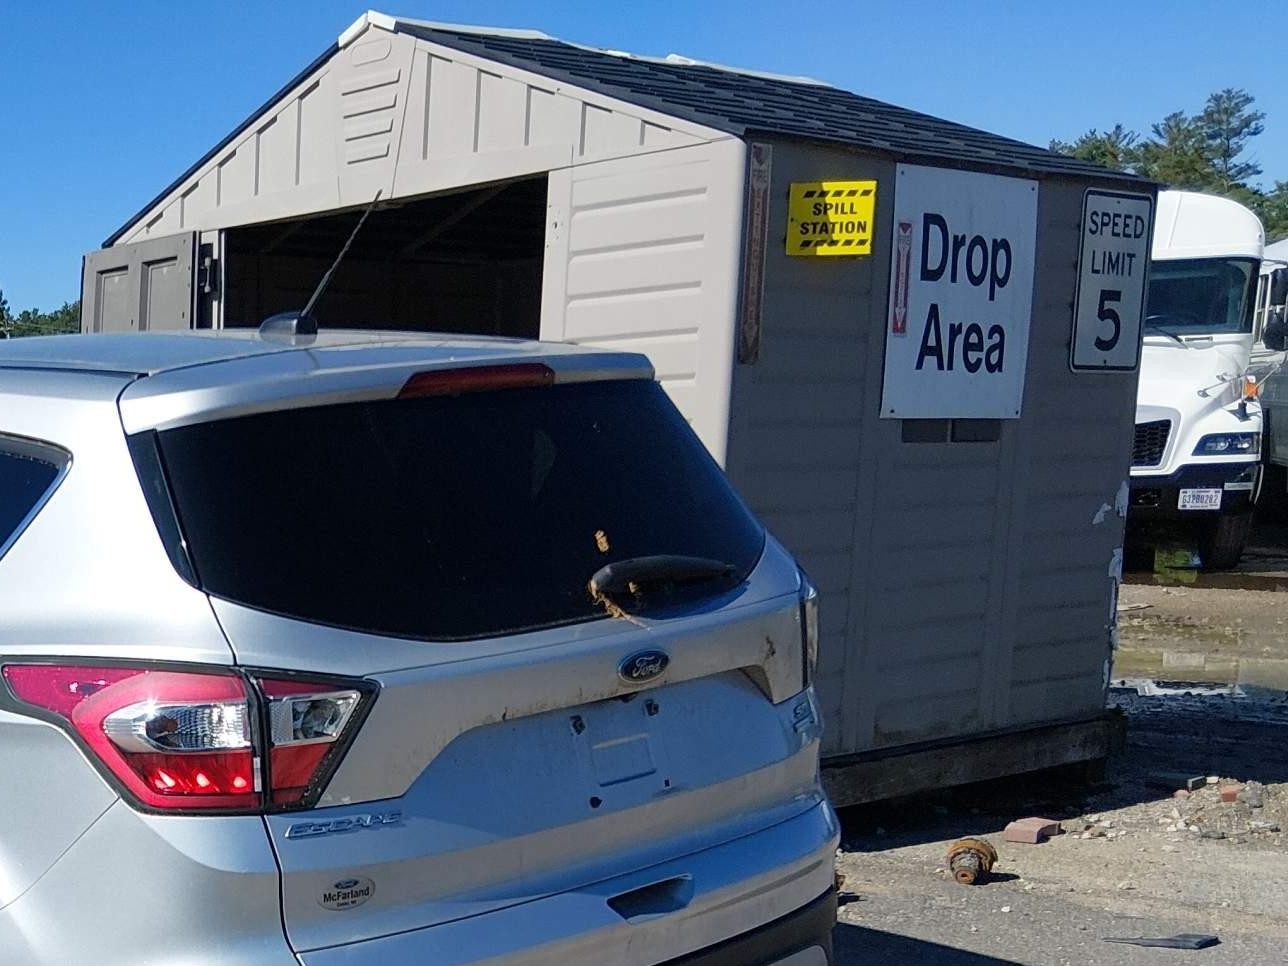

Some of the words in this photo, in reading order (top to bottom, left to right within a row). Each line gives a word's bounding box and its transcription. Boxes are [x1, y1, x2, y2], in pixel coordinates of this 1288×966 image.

[812, 202, 857, 216] SPILL
[799, 221, 867, 236] STATION
[1088, 210, 1145, 239] SPEED
[920, 212, 1012, 302] Drop
[1091, 250, 1136, 277] LIMIT
[1094, 289, 1122, 352] 5
[915, 303, 1005, 374] Area
[631, 655, 663, 678] Ford
[284, 810, 402, 839] ESCAPE
[323, 886, 370, 903] McFarland
